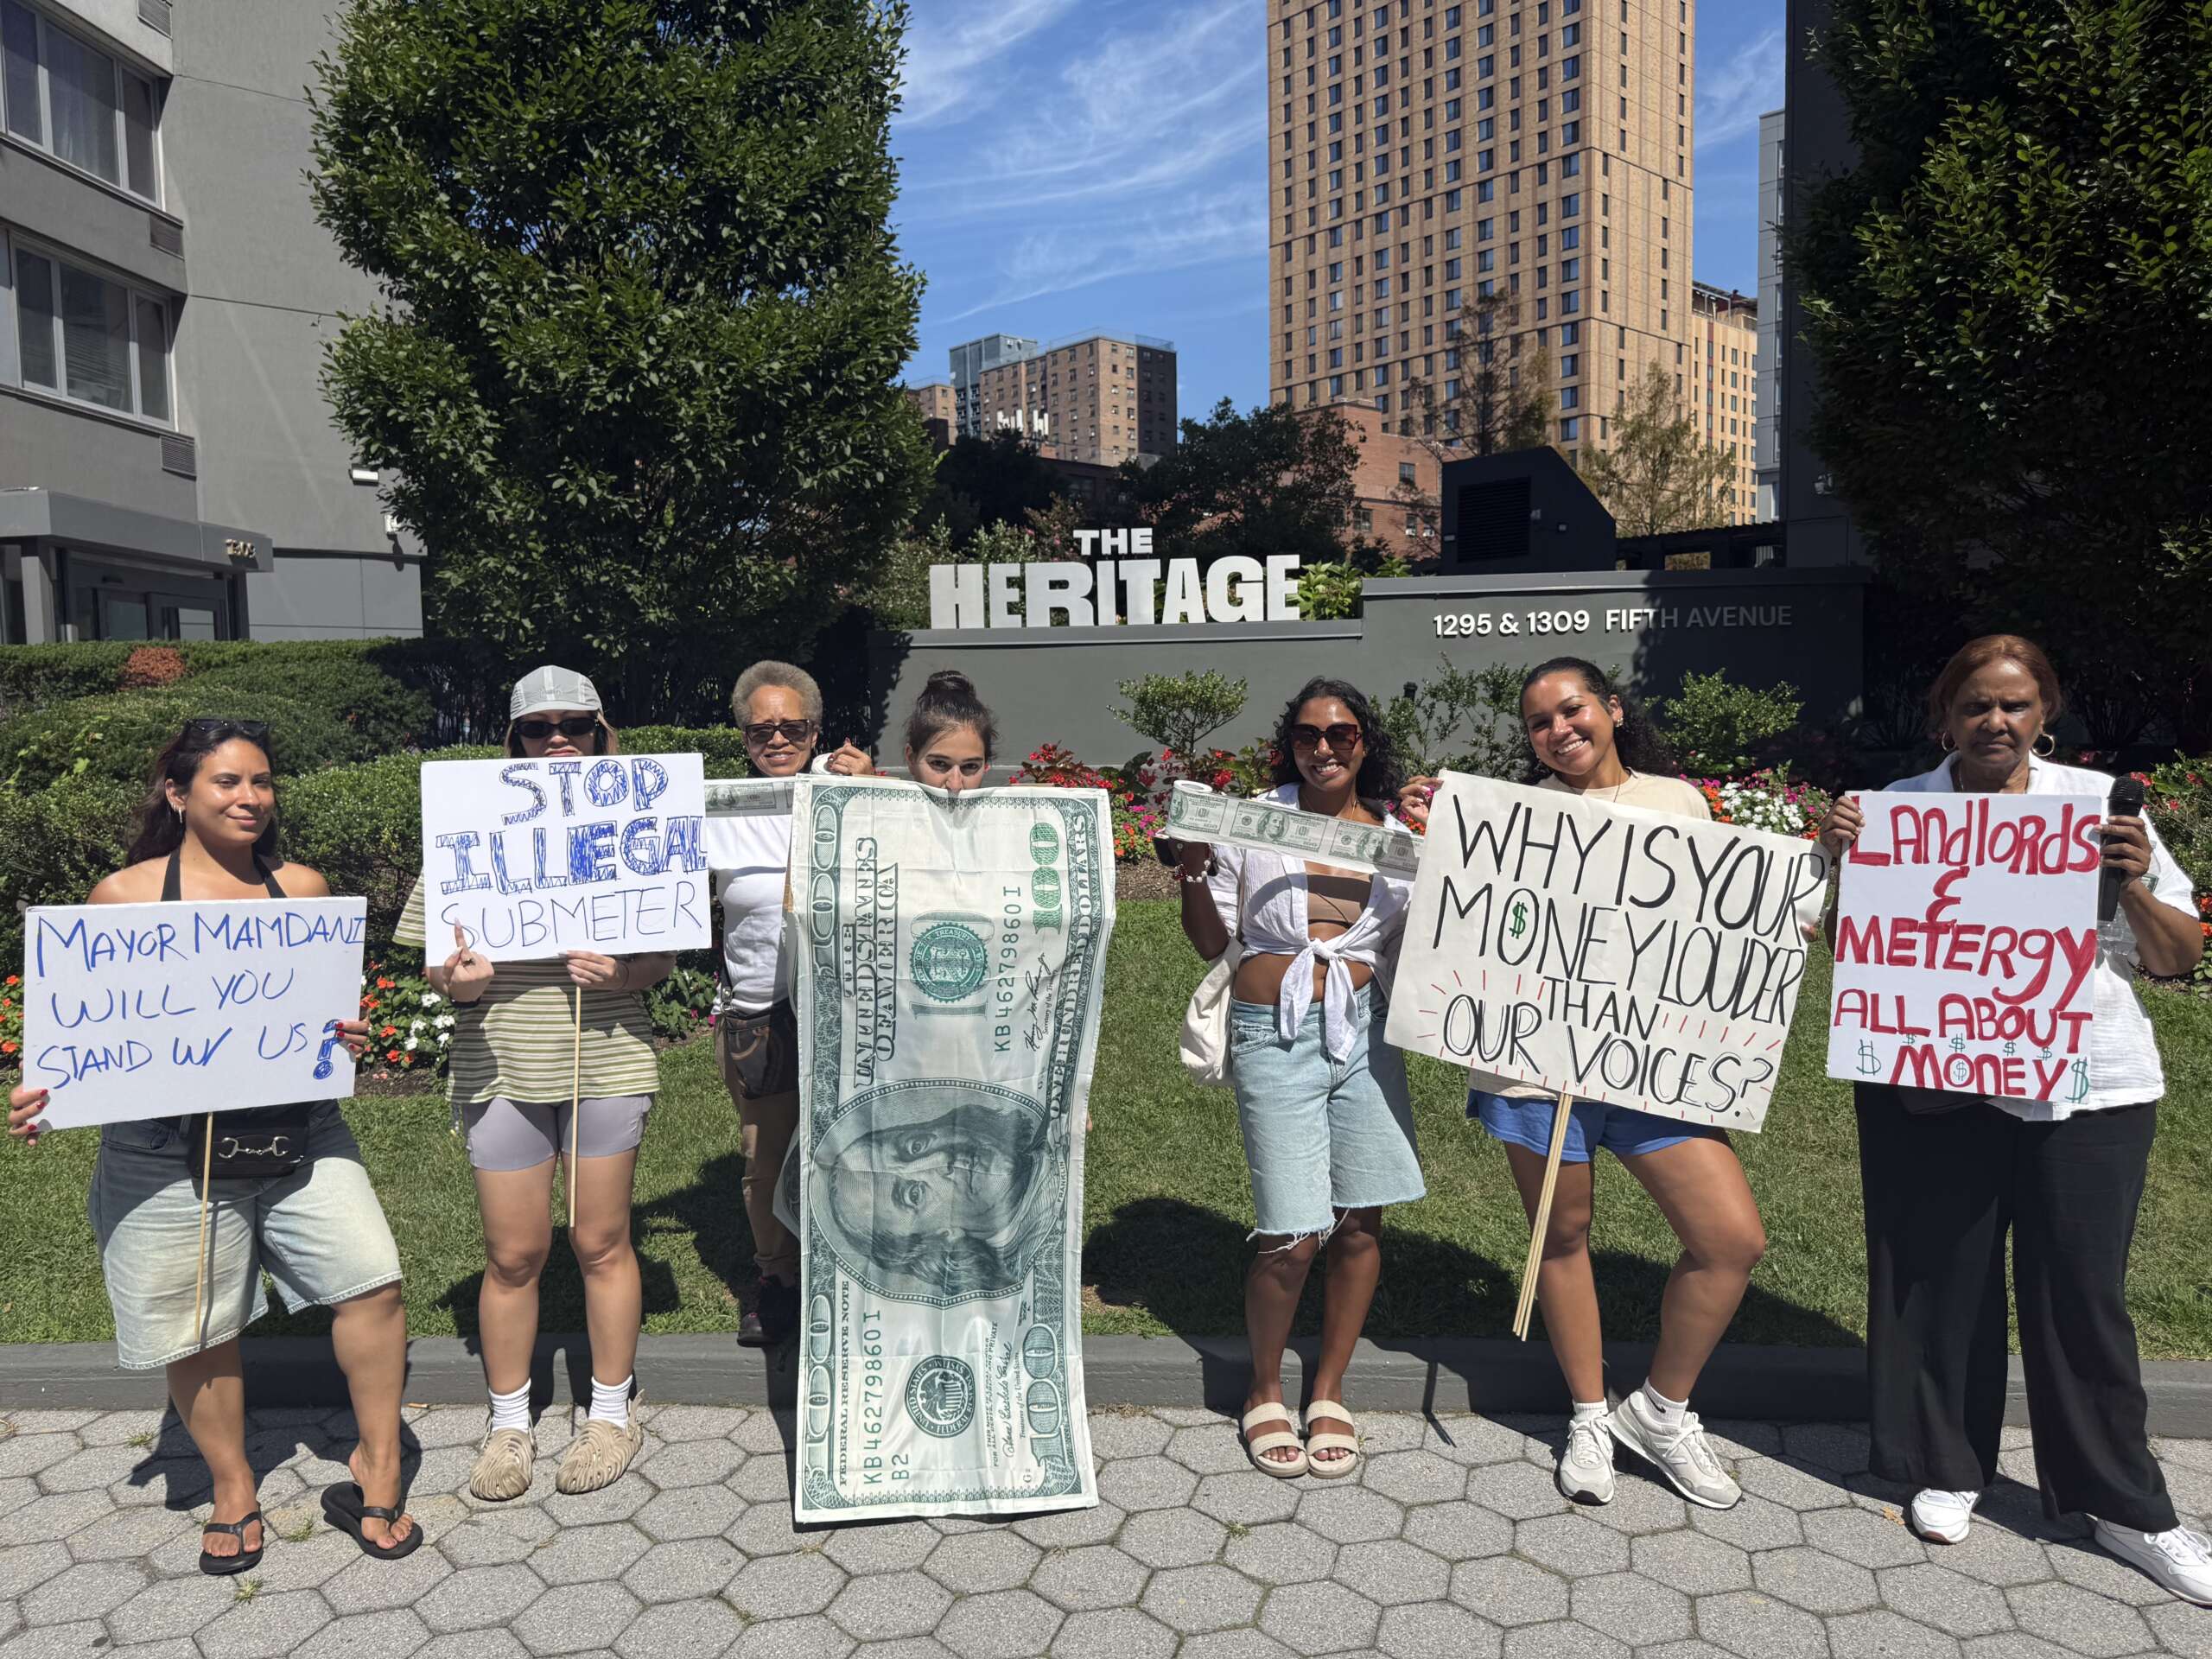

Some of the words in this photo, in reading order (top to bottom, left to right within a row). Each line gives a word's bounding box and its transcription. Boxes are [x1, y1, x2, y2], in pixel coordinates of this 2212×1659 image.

[1073, 528, 1153, 556] THE
[929, 554, 1300, 629] HERITAGE
[1433, 613, 1492, 637] 1295
[1499, 613, 1520, 635] &
[1526, 609, 1590, 634] 1309
[1605, 607, 1678, 632] FIFTH
[1687, 606, 1792, 628] AVENUE
[499, 759, 669, 825] STOP
[435, 816, 709, 896] ILLEGAL
[813, 804, 836, 971] 100
[1030, 823, 1063, 934] 100
[1071, 814, 1092, 937] DOLLARS
[1453, 795, 1612, 894] WHY
[1616, 824, 1679, 909] IS
[1688, 836, 1826, 946] YOUR
[442, 881, 702, 948] SUBMETER
[855, 836, 878, 962] STATES
[37, 916, 188, 977] MAYOR
[194, 912, 365, 953] MAMDANI
[875, 862, 898, 1020] AMERICA
[995, 904, 1021, 1015] 46279860
[1433, 875, 1667, 991] MONEY
[1658, 919, 1805, 1027] LOUDER
[52, 984, 195, 1028] WILL
[212, 968, 294, 1010] YOU
[853, 963, 876, 1089] UNITED
[1043, 1008, 1052, 1035] Secretary
[1055, 937, 1090, 1065] HUNDRED
[1544, 976, 1660, 1040] THAN
[1834, 988, 1930, 1037] ALL
[1938, 993, 2093, 1053] ABOUT
[37, 1040, 152, 1089] STAND
[173, 1027, 232, 1066] W/
[876, 1018, 896, 1062] OF
[995, 1023, 1010, 1052] KB
[1444, 995, 1542, 1074] OUR
[1567, 1025, 1774, 1117] VOICES?
[1049, 1066, 1066, 1120] ONE
[1057, 1161, 1066, 1203] FRANKLIN
[842, 1281, 850, 1323] NOTE
[988, 1321, 998, 1353] PRIVATE
[806, 1294, 831, 1480] 100
[841, 1325, 849, 1406] RESERVE
[864, 1329, 883, 1451] 46279860
[1023, 1323, 1065, 1468] 100
[839, 1408, 849, 1486] FEDERAL
[863, 1455, 882, 1484] KB
[892, 1453, 910, 1480] B2
